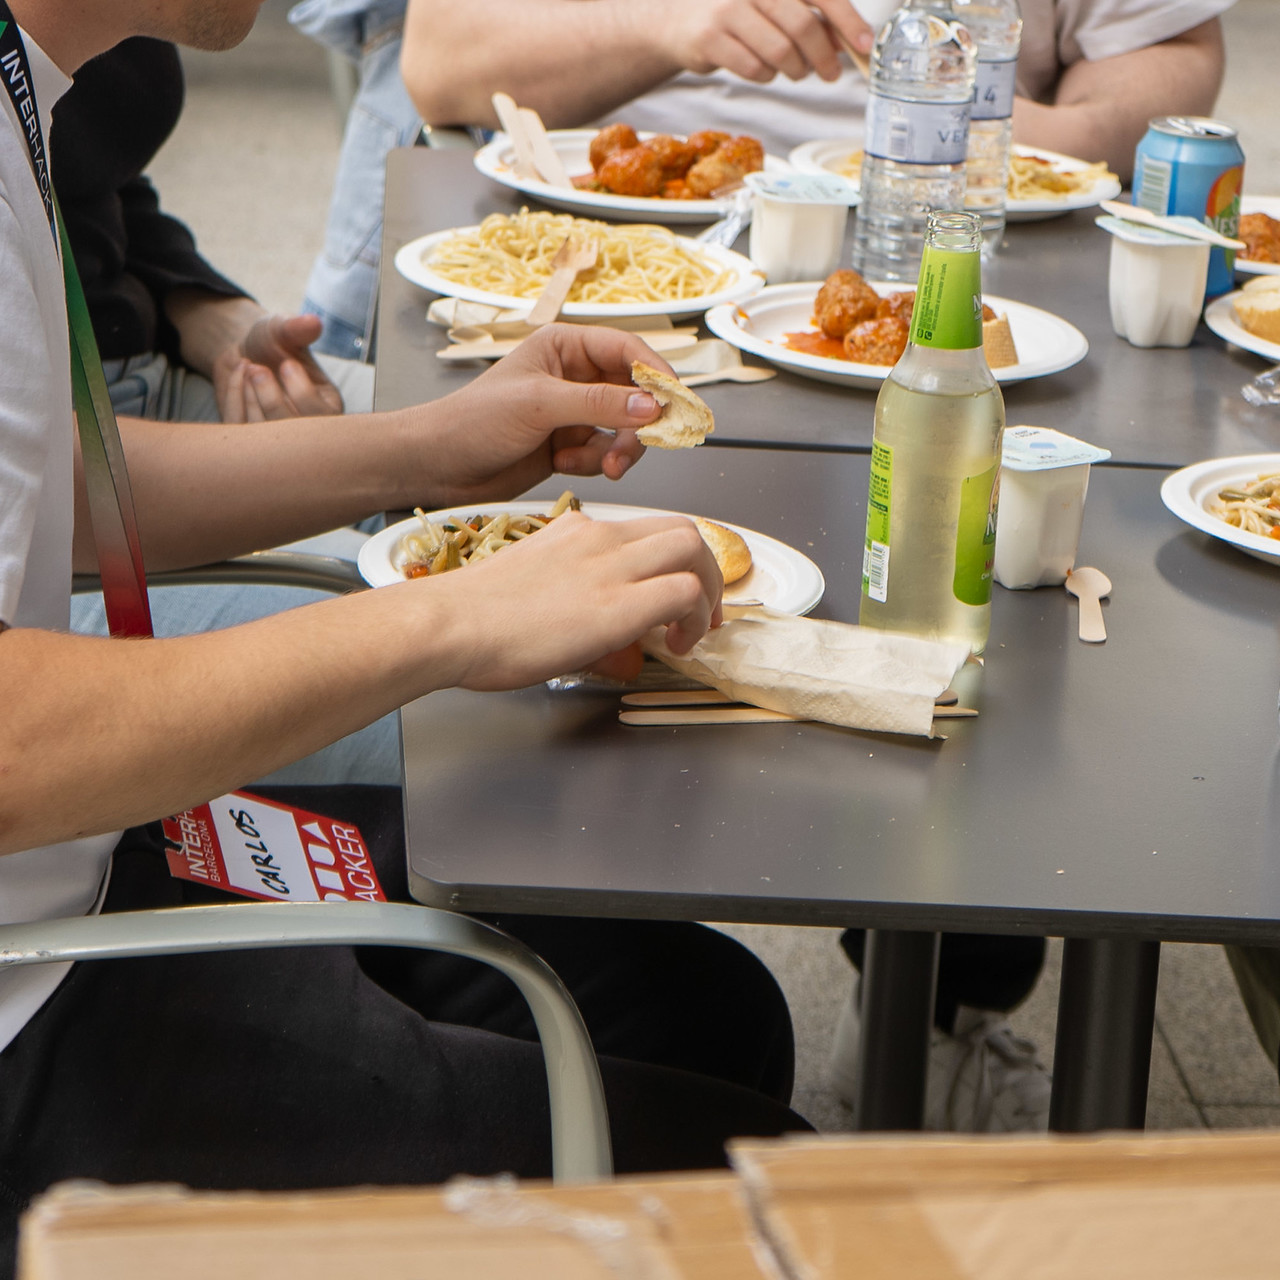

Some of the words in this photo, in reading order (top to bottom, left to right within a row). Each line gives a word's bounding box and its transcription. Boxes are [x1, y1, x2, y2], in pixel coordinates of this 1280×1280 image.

[0, 48, 53, 212] INTERHACK
[177, 807, 209, 880] INTERH
[196, 818, 221, 883] BARCELONA
[228, 808, 290, 895] CARLOS
[330, 823, 380, 902] ACKER
